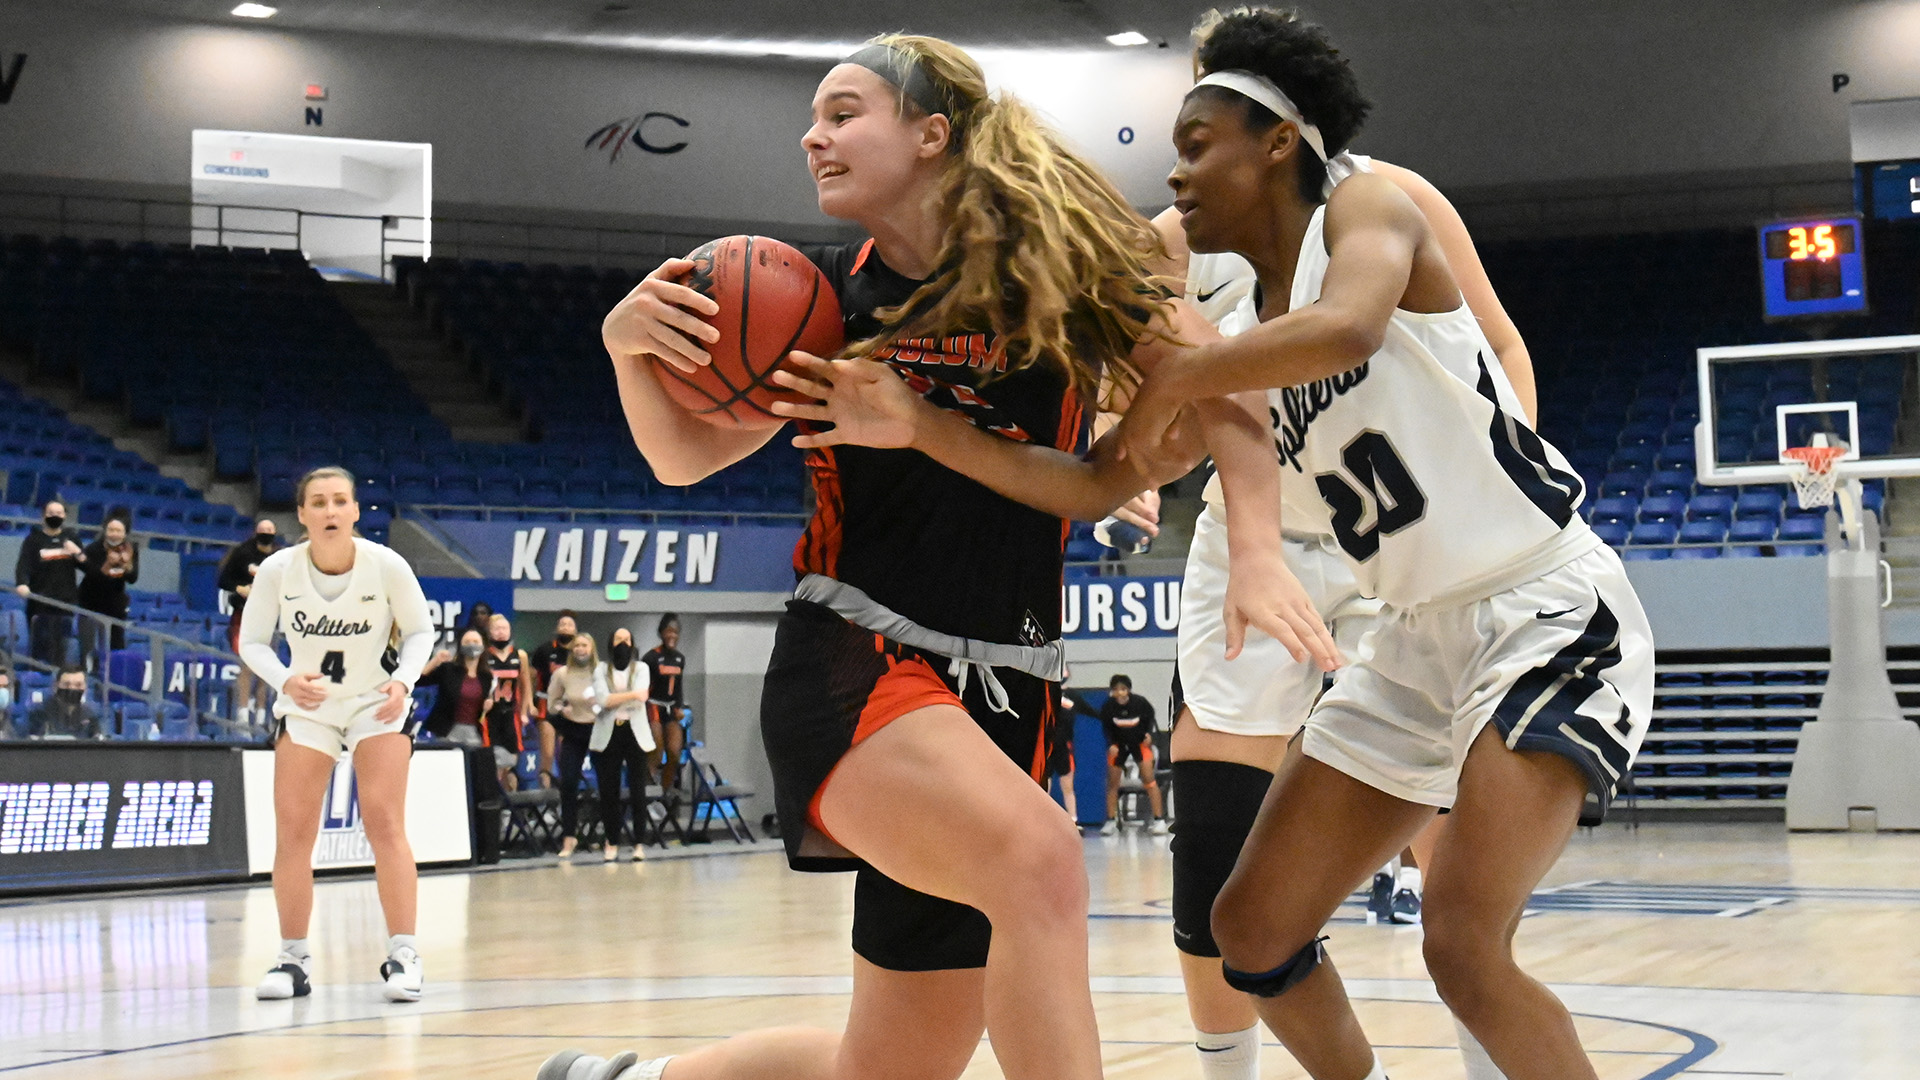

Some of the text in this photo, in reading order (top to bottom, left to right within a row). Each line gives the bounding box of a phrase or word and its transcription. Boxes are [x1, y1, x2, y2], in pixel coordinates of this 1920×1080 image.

[1832, 74, 1850, 93] P
[305, 107, 322, 126] N
[1118, 126, 1135, 145] O
[1314, 427, 1429, 565] 20
[511, 527, 718, 584] KAIZEN
[291, 610, 372, 639] Splitters
[320, 650, 346, 685] 4
[0, 781, 110, 854] URNER
